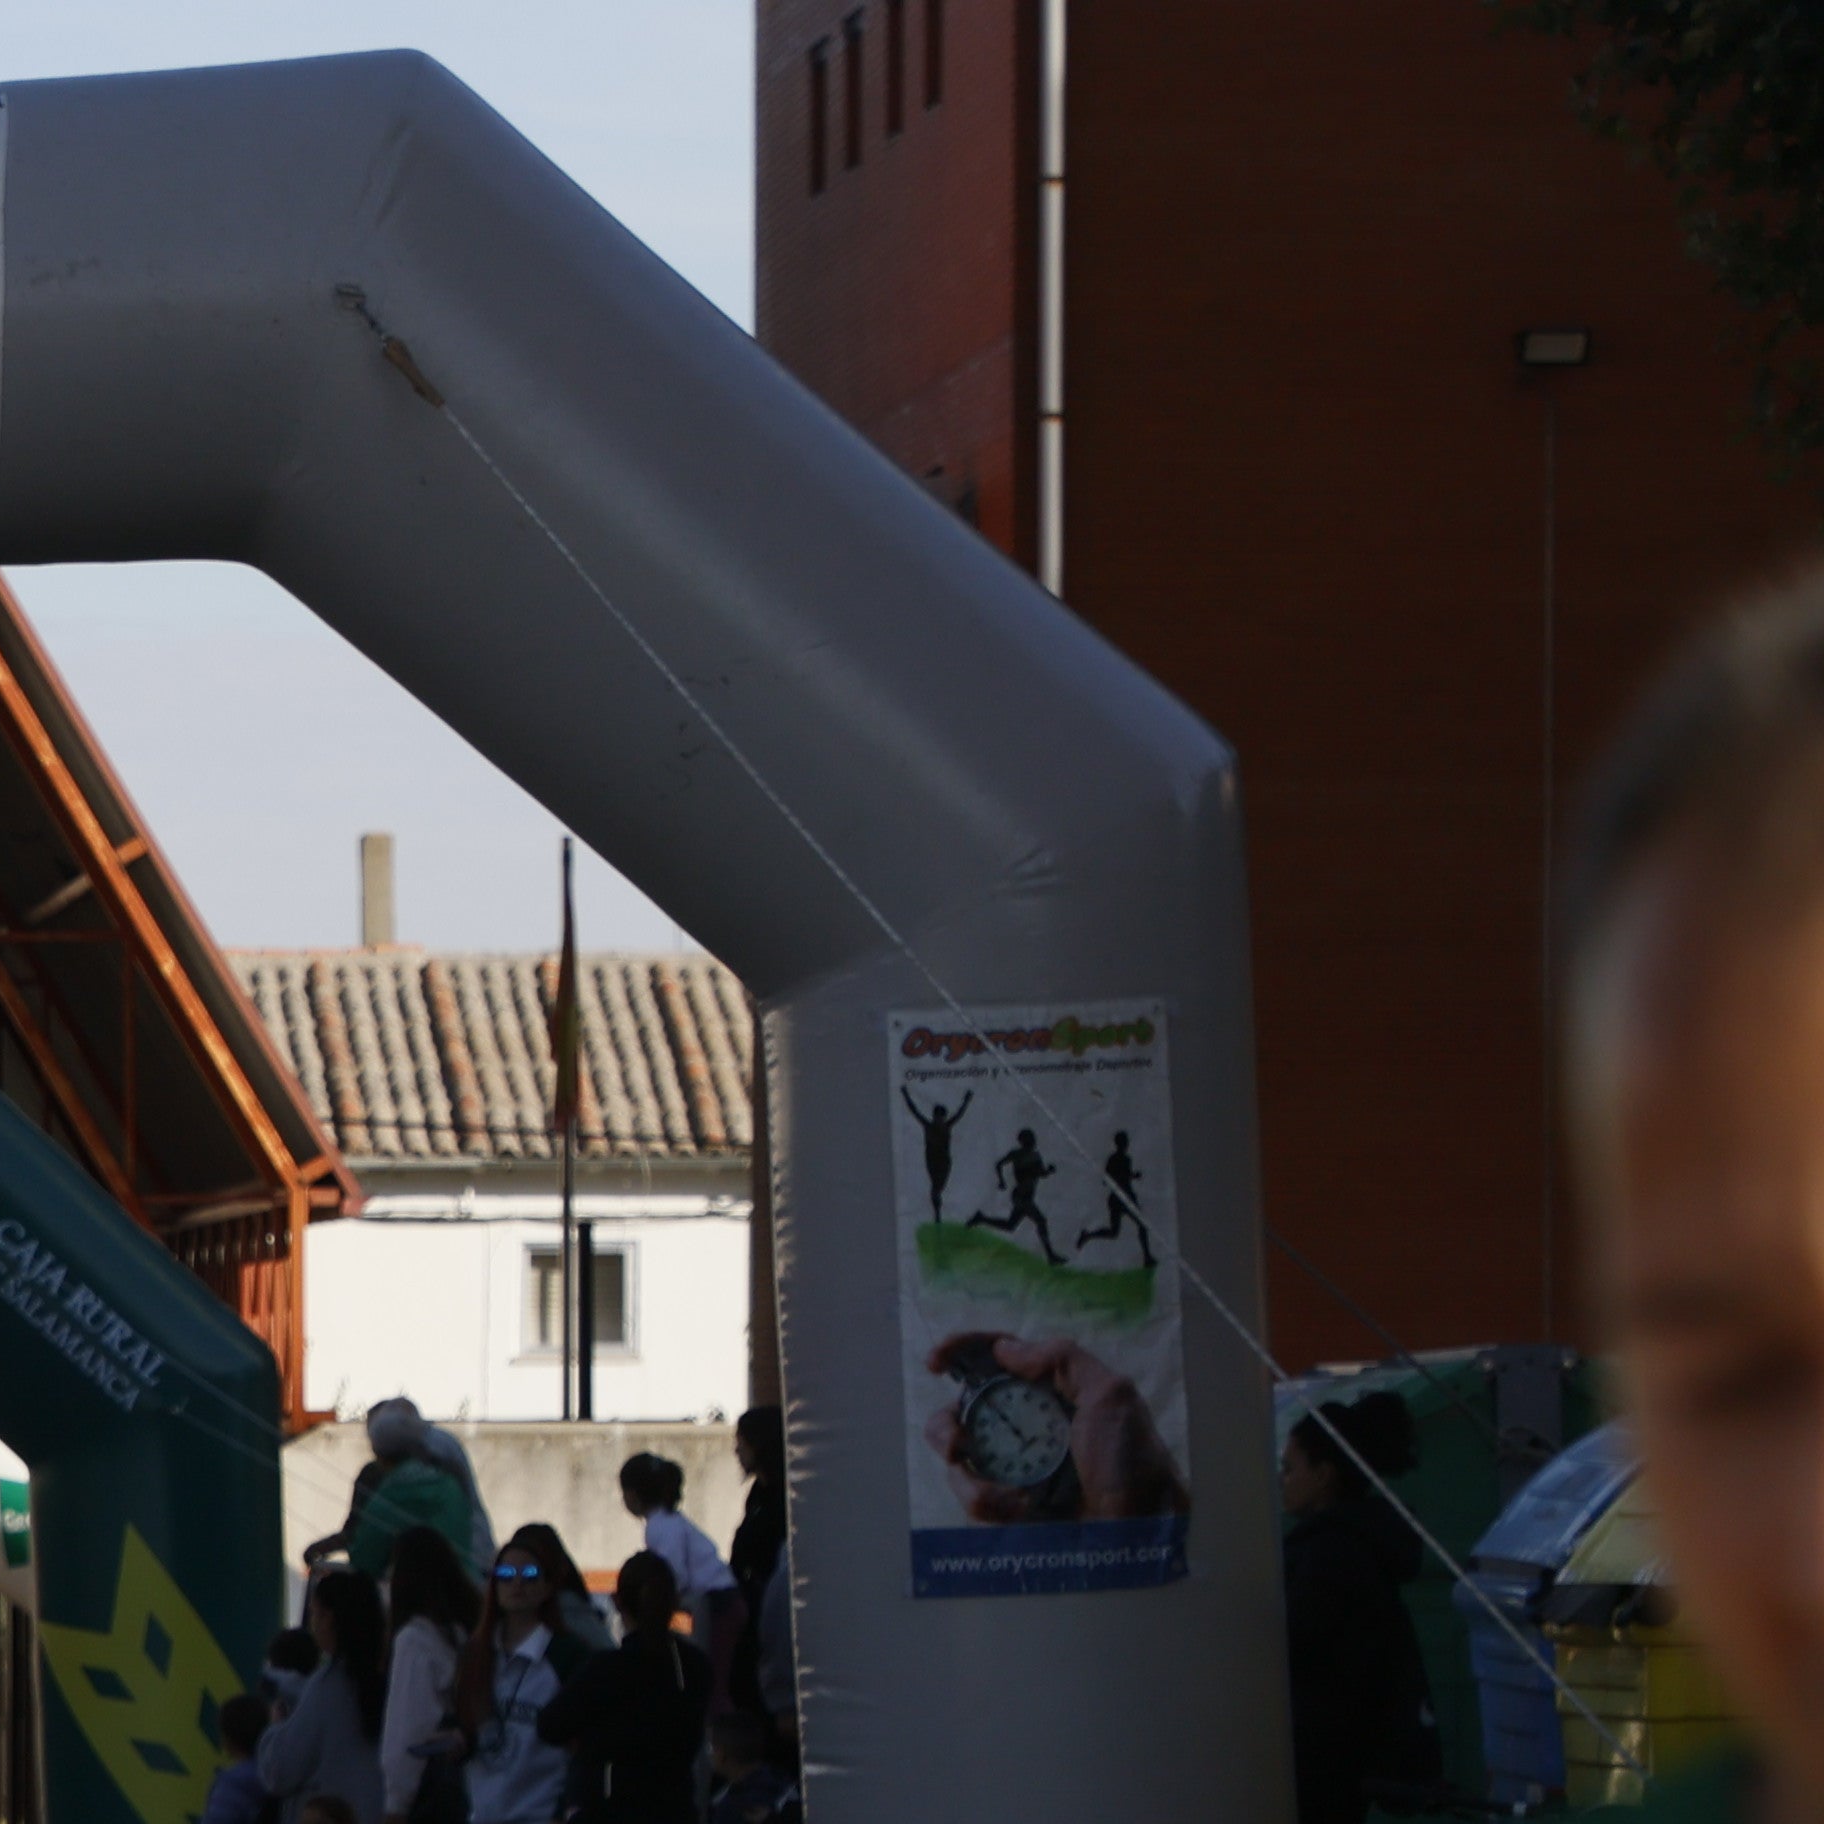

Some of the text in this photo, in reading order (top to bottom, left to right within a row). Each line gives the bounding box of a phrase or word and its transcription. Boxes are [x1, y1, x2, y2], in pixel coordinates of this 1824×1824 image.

[902, 1016, 1155, 1063] OrycronSport
[1, 1278, 140, 1412] SALAMANCA
[65, 1283, 165, 1386] RURAL
